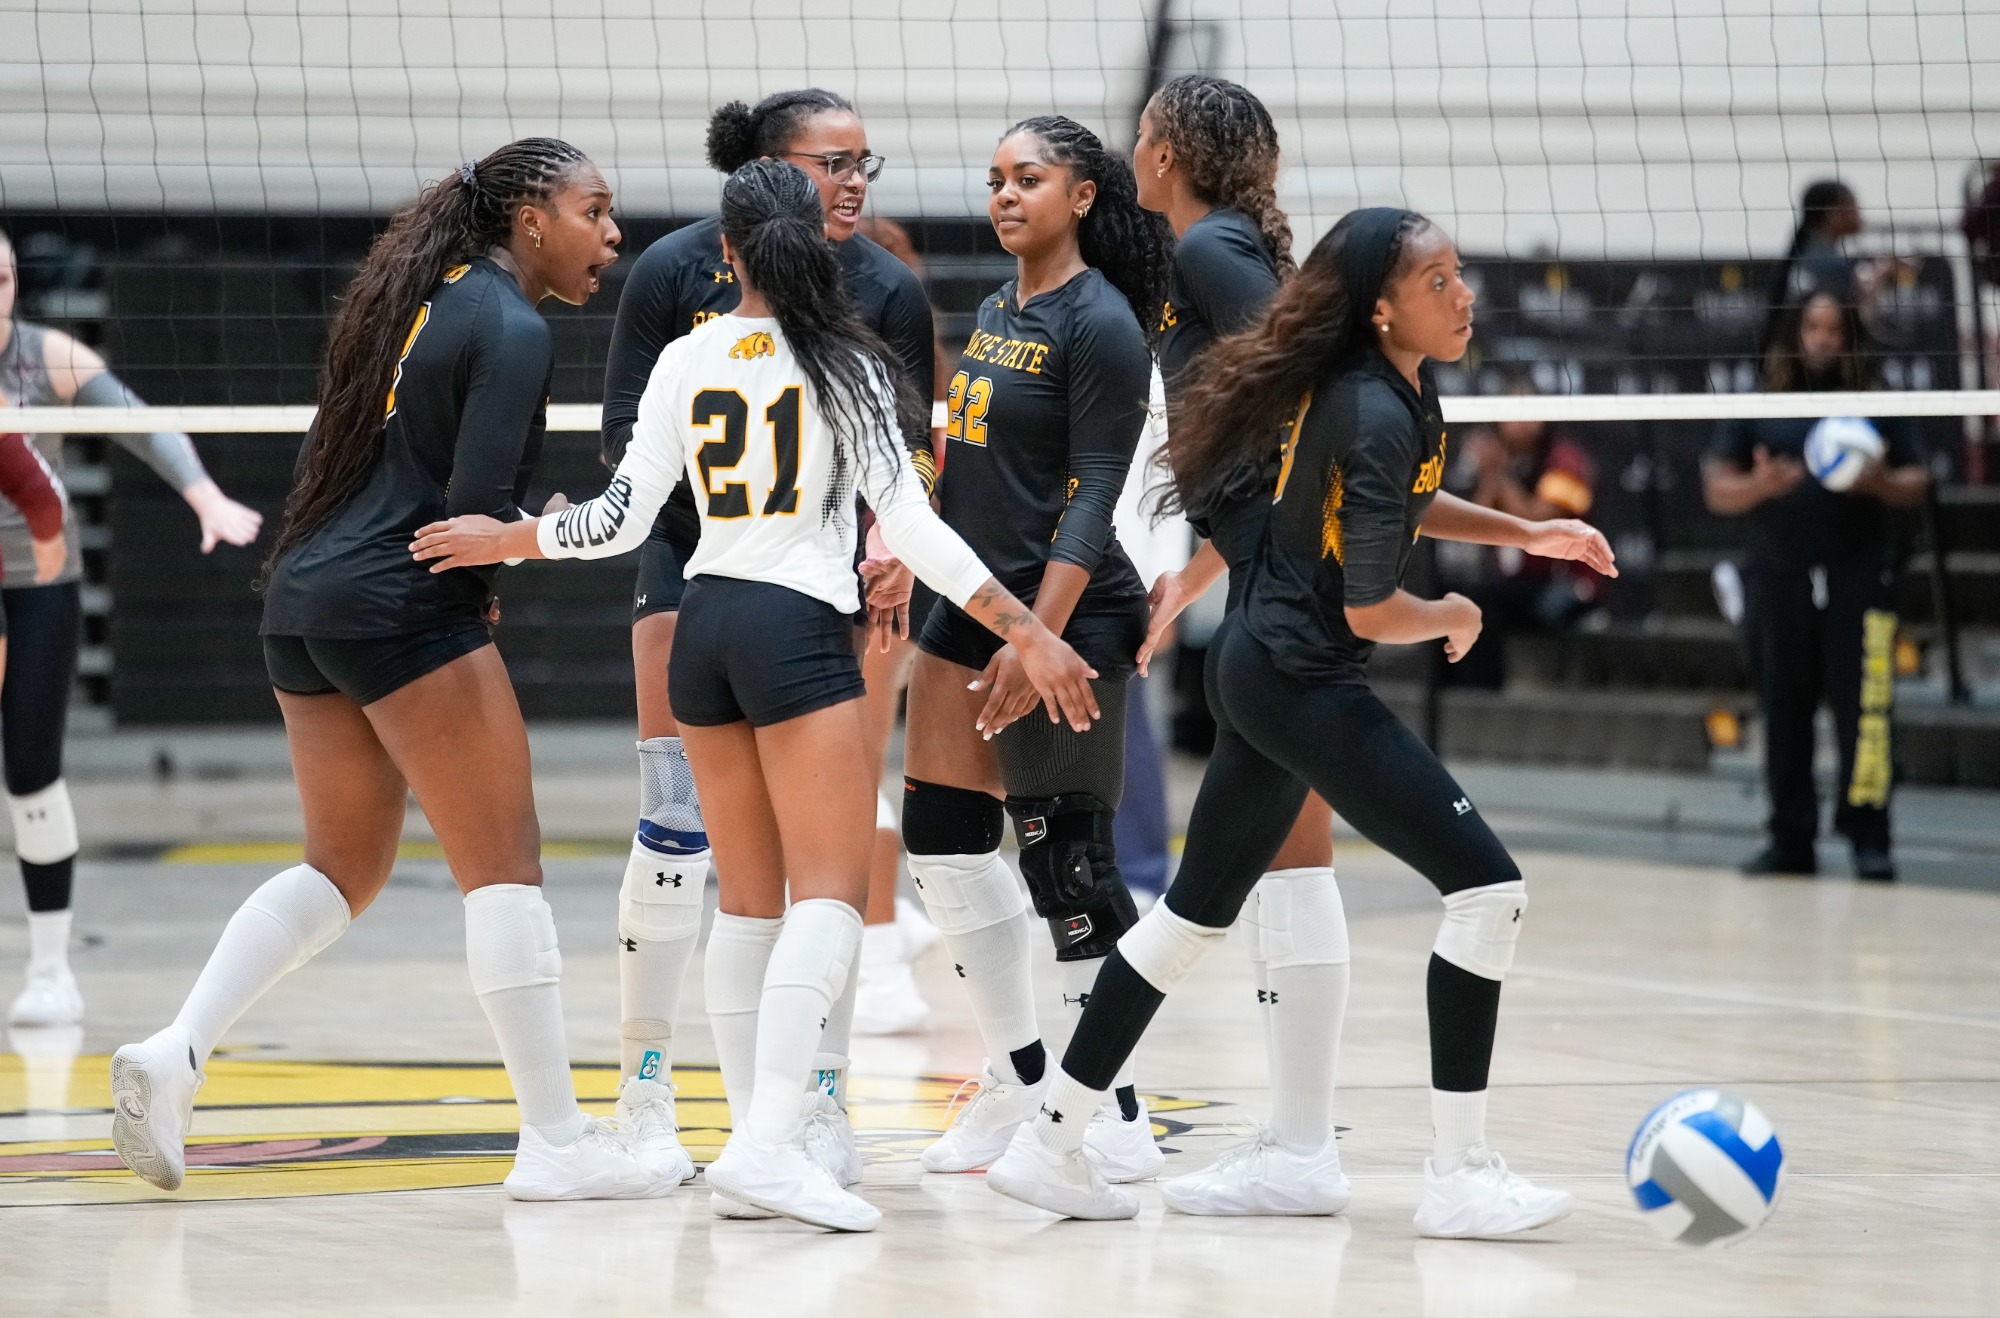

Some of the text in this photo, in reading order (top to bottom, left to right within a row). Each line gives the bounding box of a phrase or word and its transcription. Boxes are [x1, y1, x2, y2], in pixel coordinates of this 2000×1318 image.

[989, 339, 1049, 375] STATE
[946, 370, 994, 447] 22
[690, 384, 803, 521] 21
